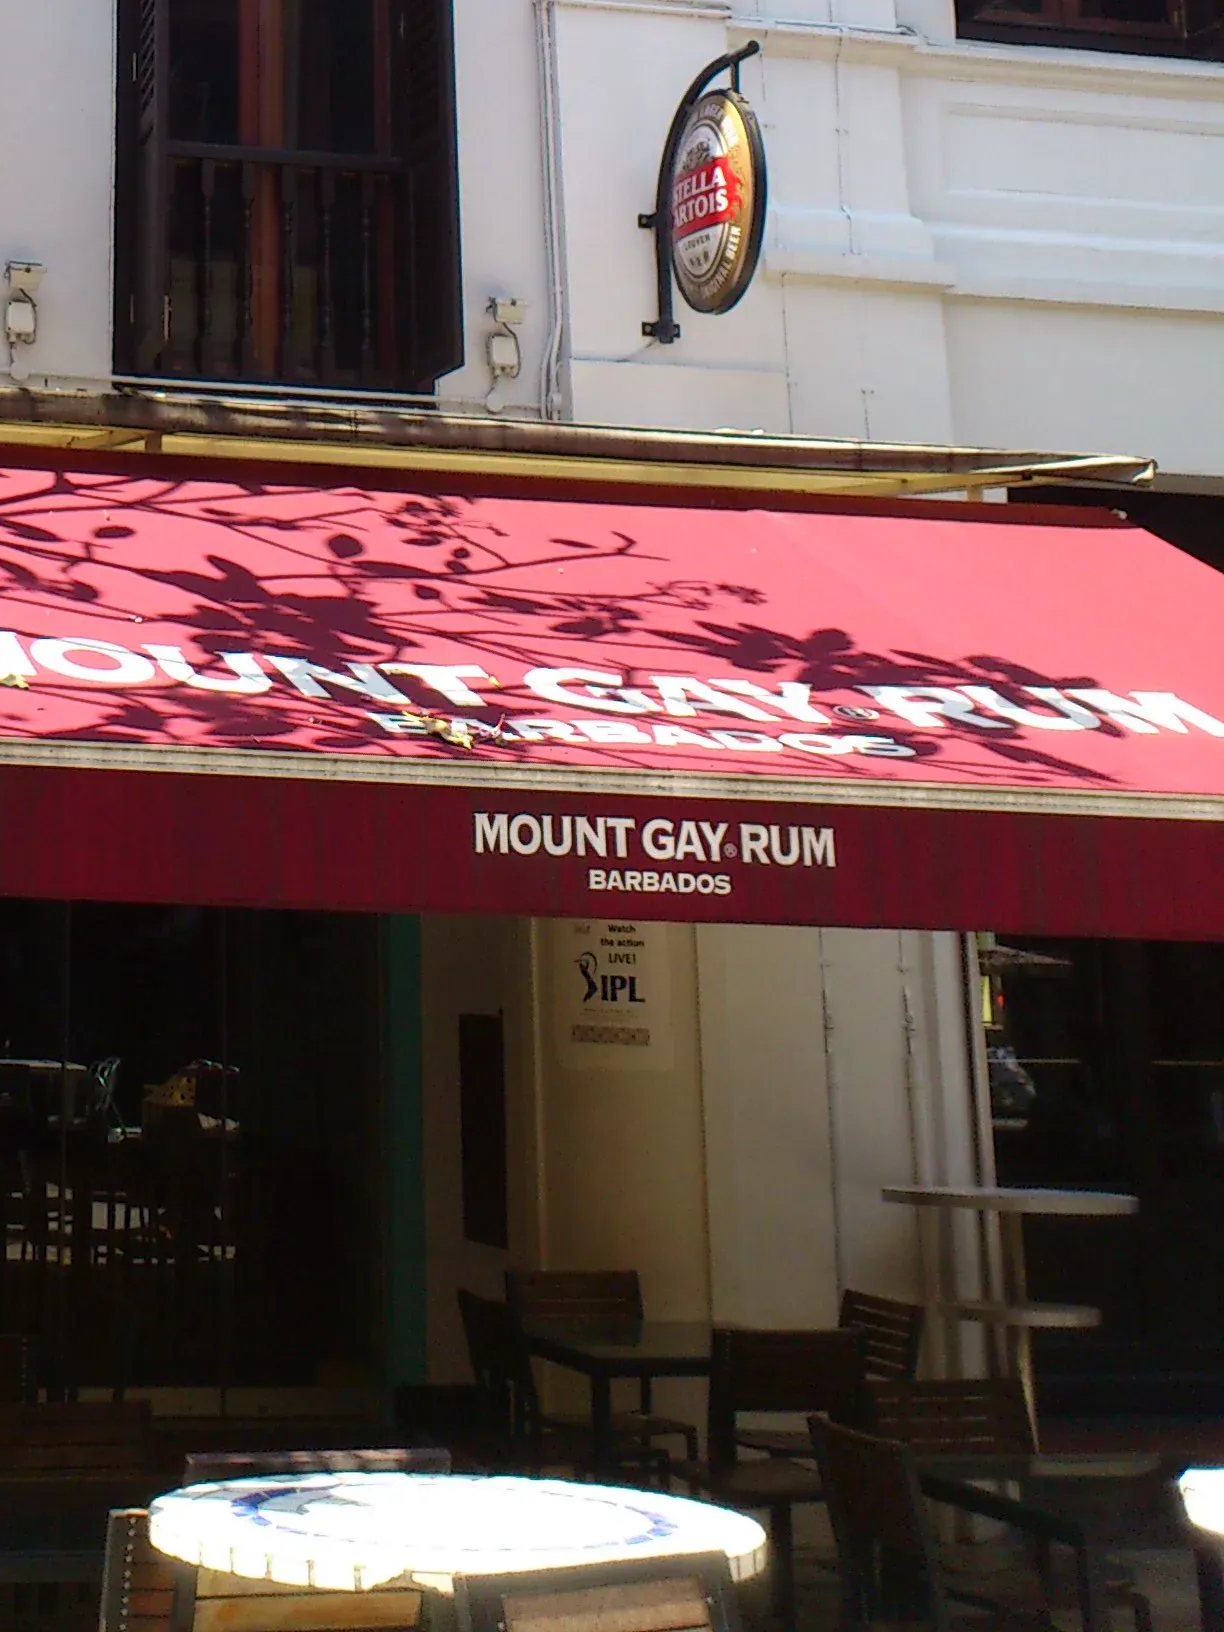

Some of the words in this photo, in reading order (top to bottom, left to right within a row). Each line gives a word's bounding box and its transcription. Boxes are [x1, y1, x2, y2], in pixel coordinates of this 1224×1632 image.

[674, 166, 727, 205] STELLA
[673, 188, 729, 226] ARTOIS
[523, 666, 834, 726] GAY
[853, 684, 1224, 737] RUM
[473, 811, 636, 858] MOUNT
[641, 818, 729, 862] GAY
[739, 822, 837, 868] RUM
[588, 868, 732, 895] BARBADOS
[600, 937, 614, 947] the
[616, 938, 645, 948] action
[607, 923, 636, 934] Watch
[608, 953, 637, 965] LIVE!
[600, 974, 646, 1003] IPL
